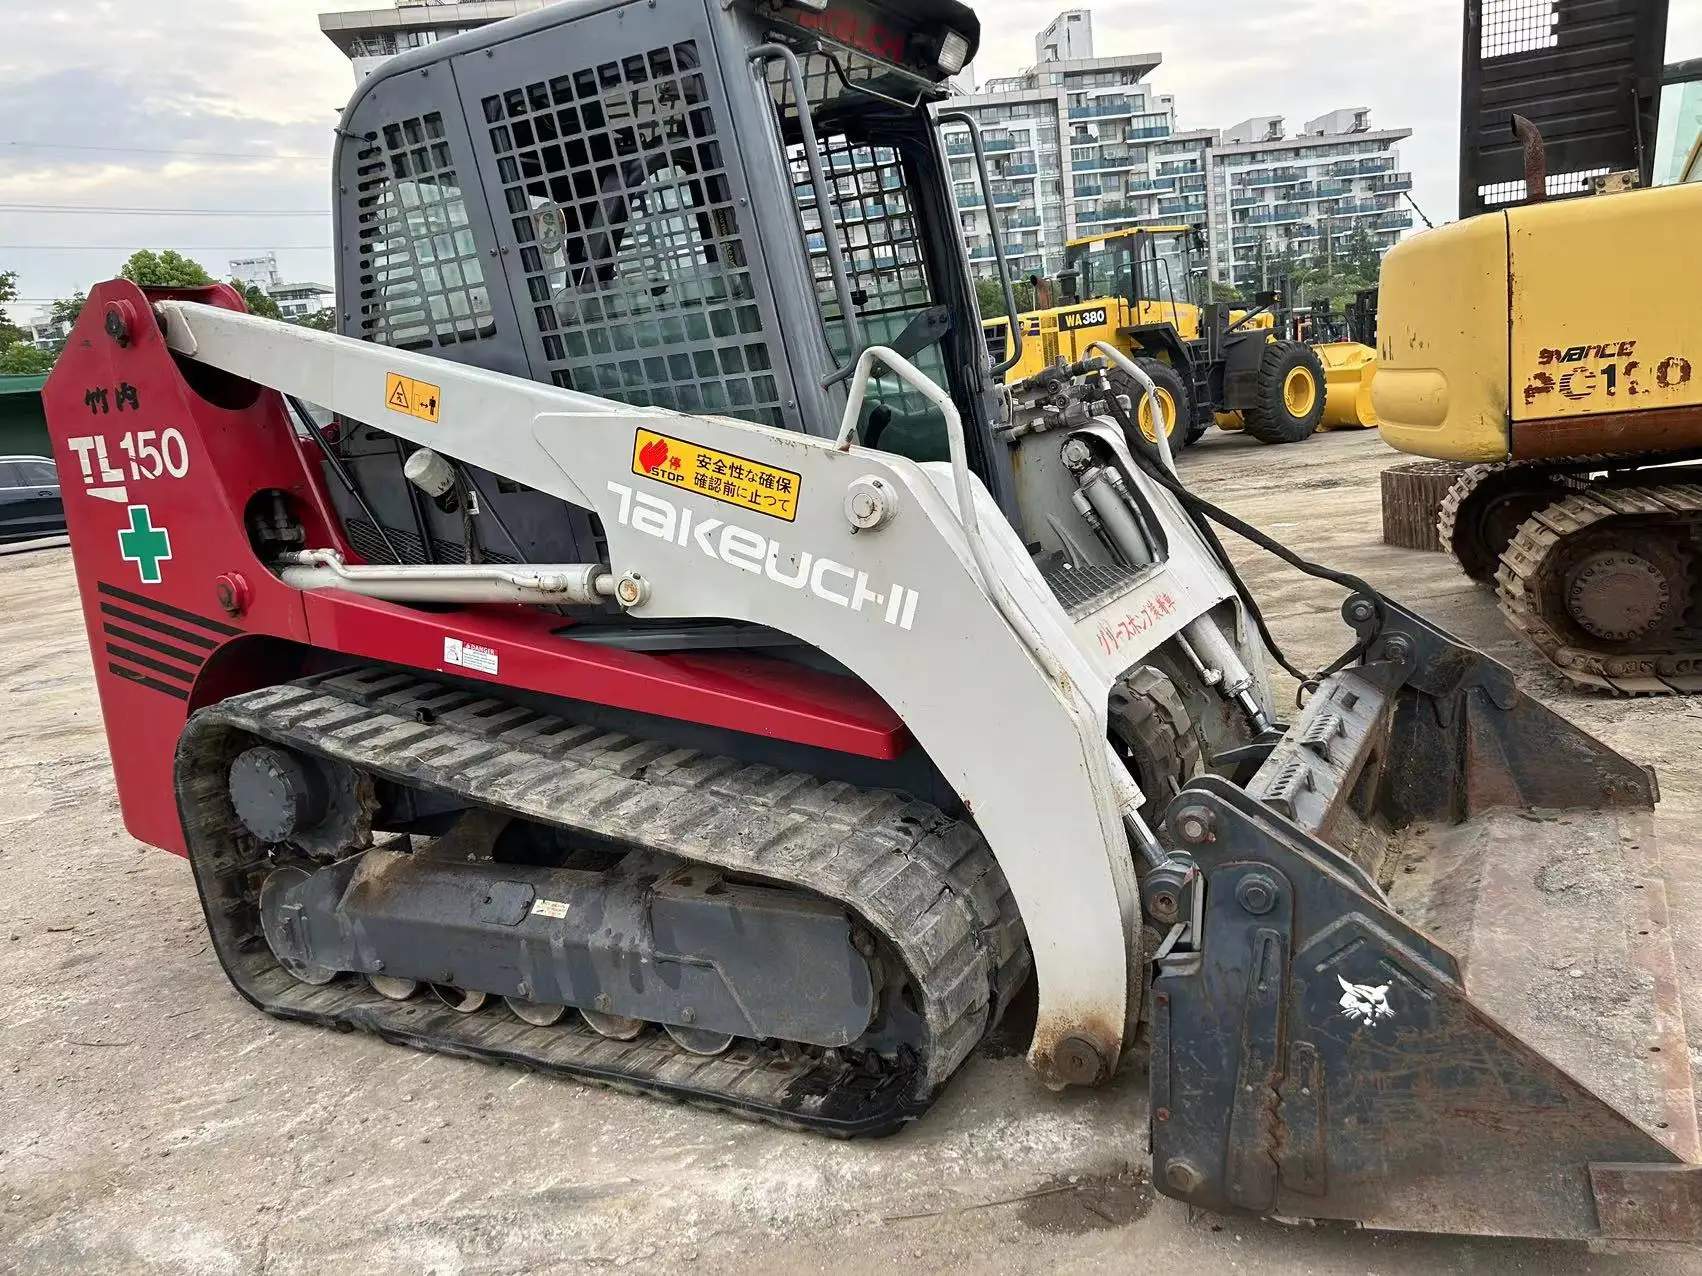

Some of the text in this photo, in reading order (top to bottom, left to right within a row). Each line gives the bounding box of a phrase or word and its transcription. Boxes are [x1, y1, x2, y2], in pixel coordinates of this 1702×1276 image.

[1065, 310, 1105, 328] WA380
[67, 427, 189, 484] TL150
[651, 466, 685, 482] STOP
[471, 644, 495, 656] DANGER
